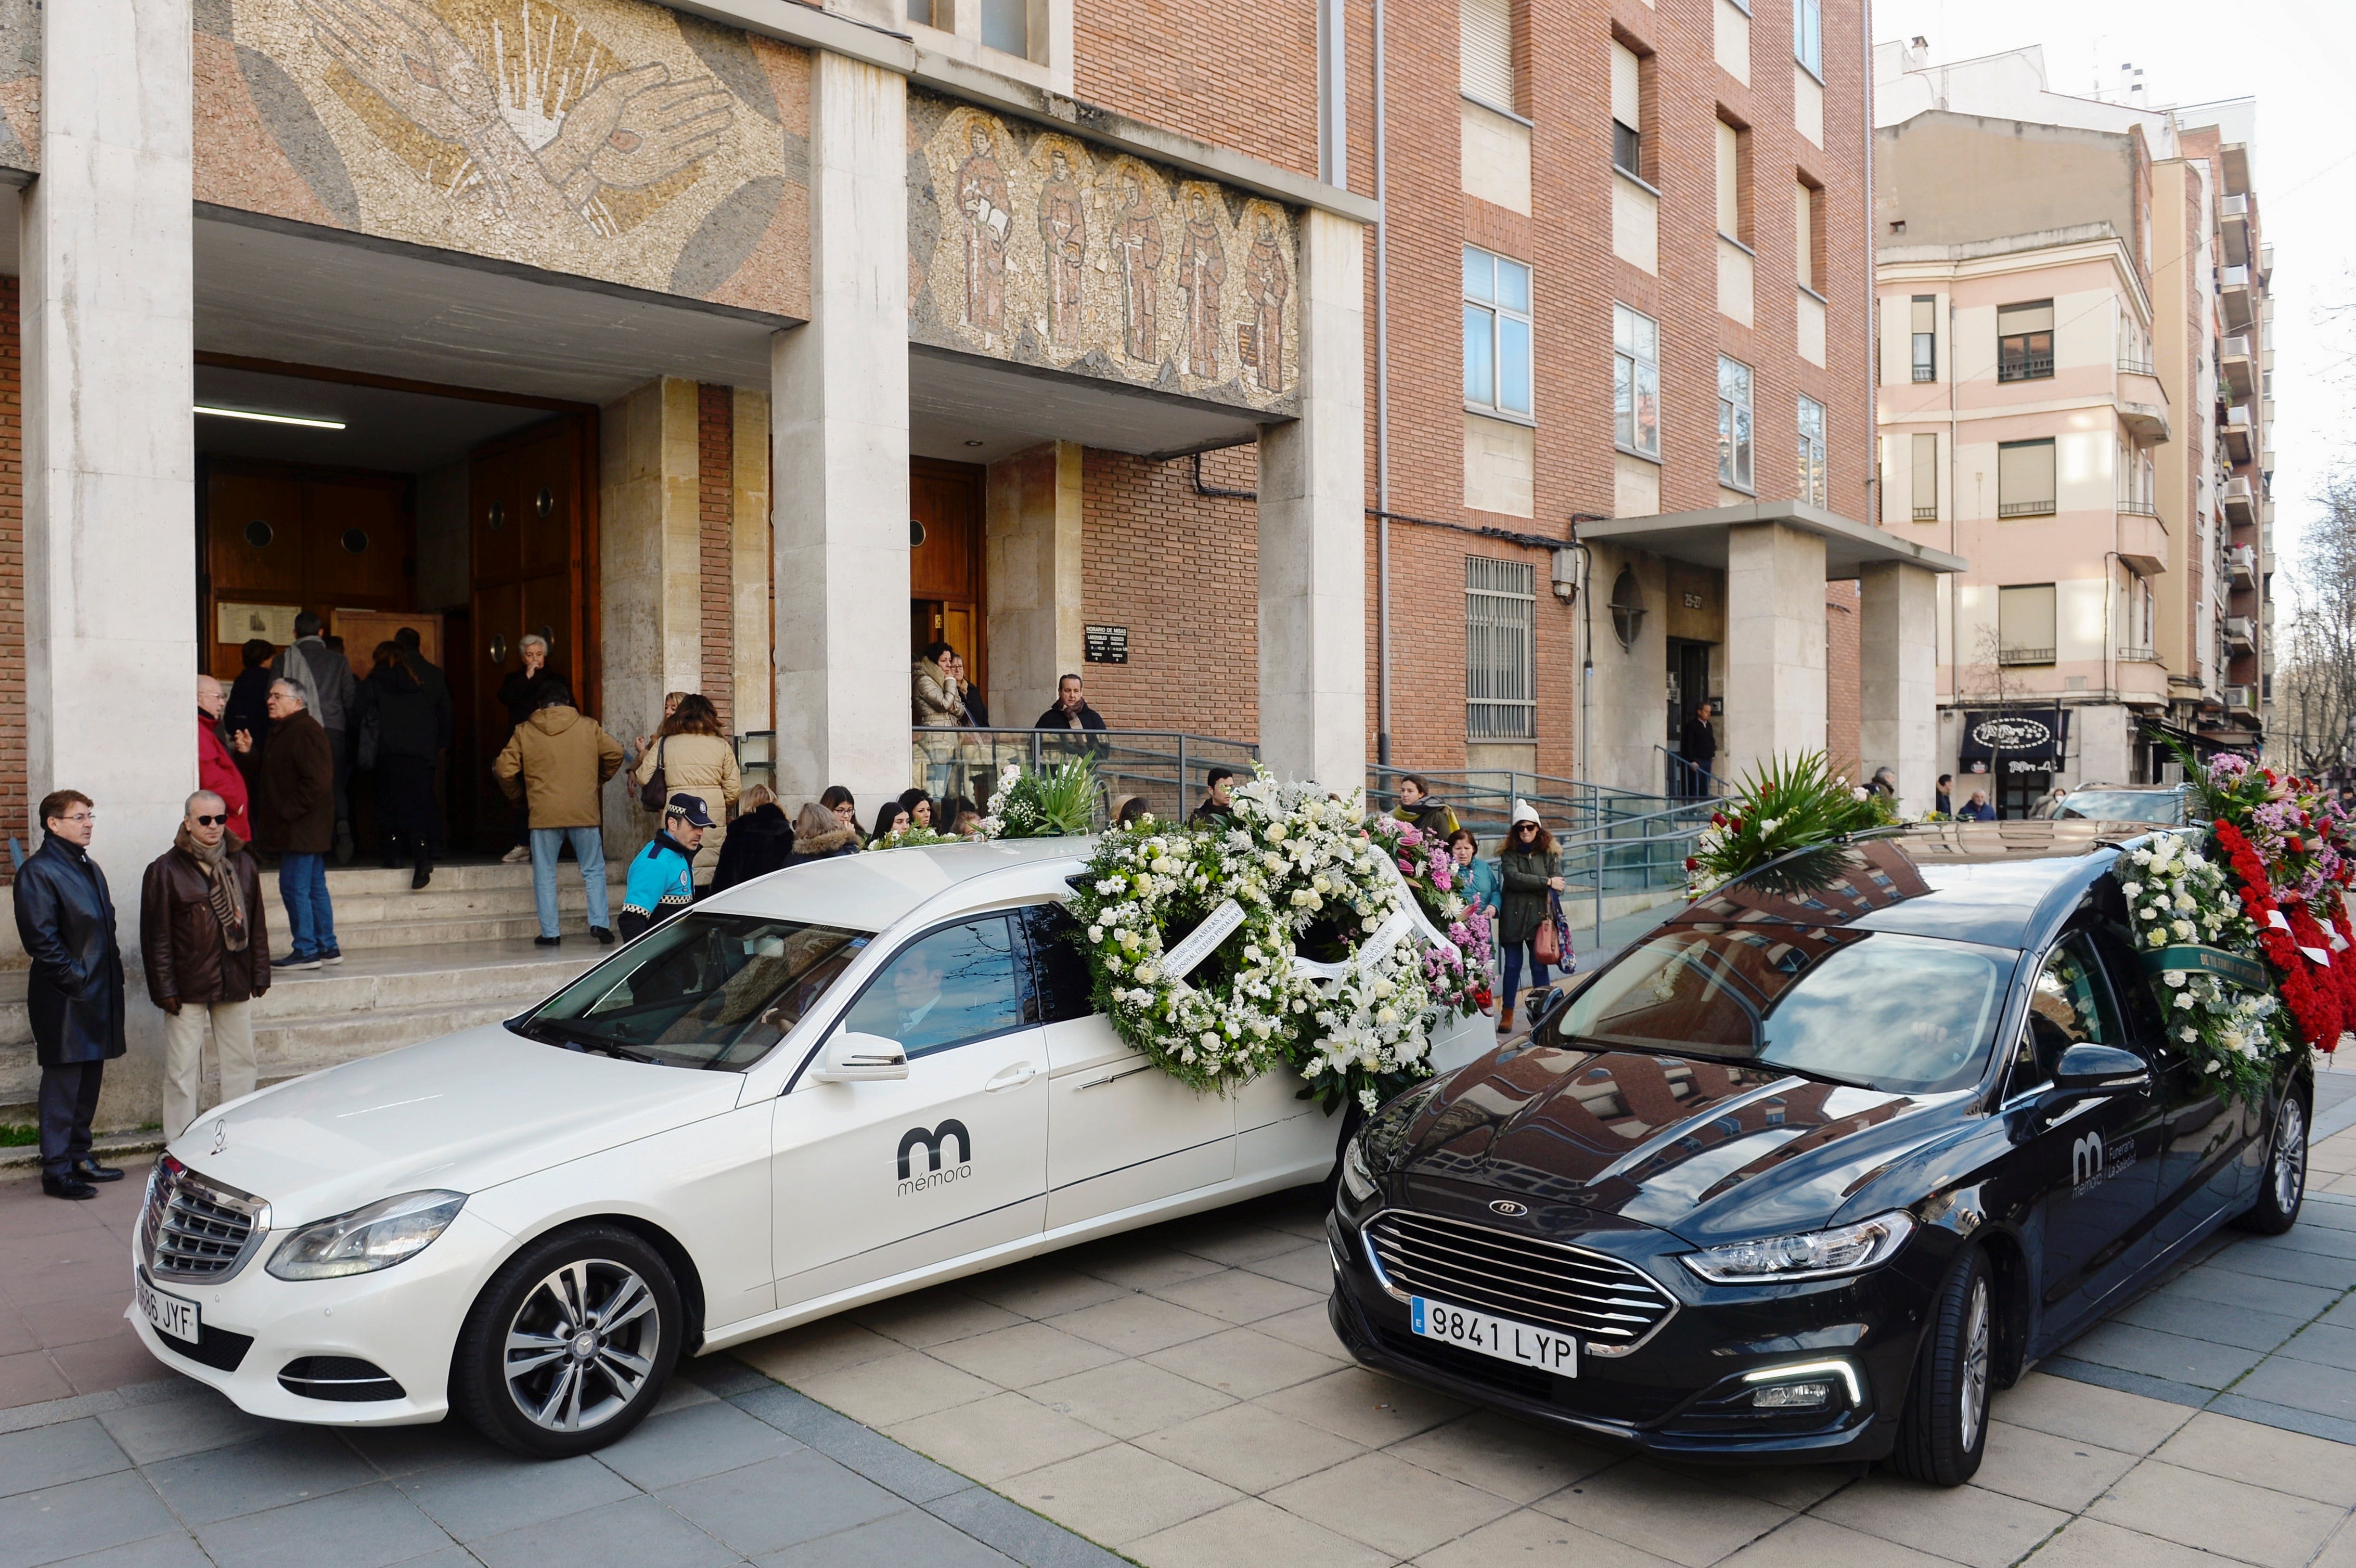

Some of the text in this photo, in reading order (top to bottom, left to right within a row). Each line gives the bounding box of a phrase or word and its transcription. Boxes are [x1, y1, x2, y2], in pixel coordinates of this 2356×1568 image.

[1170, 948, 1190, 965] CARIÑO,
[1187, 917, 1221, 949] COMPAÑERAS,
[1173, 953, 1197, 977] PERSONAL
[1195, 935, 1216, 955] COLEGIO
[1215, 910, 1243, 937] PINOALBAR
[1365, 942, 1379, 956] LAS
[2108, 1150, 2136, 1178] La Soledad
[2109, 1136, 2134, 1161] Funeraria
[898, 1165, 971, 1197] mémora
[163, 1301, 190, 1335] JYF
[1415, 1318, 1422, 1328] E
[1433, 1307, 1570, 1368] 9841 LYP
